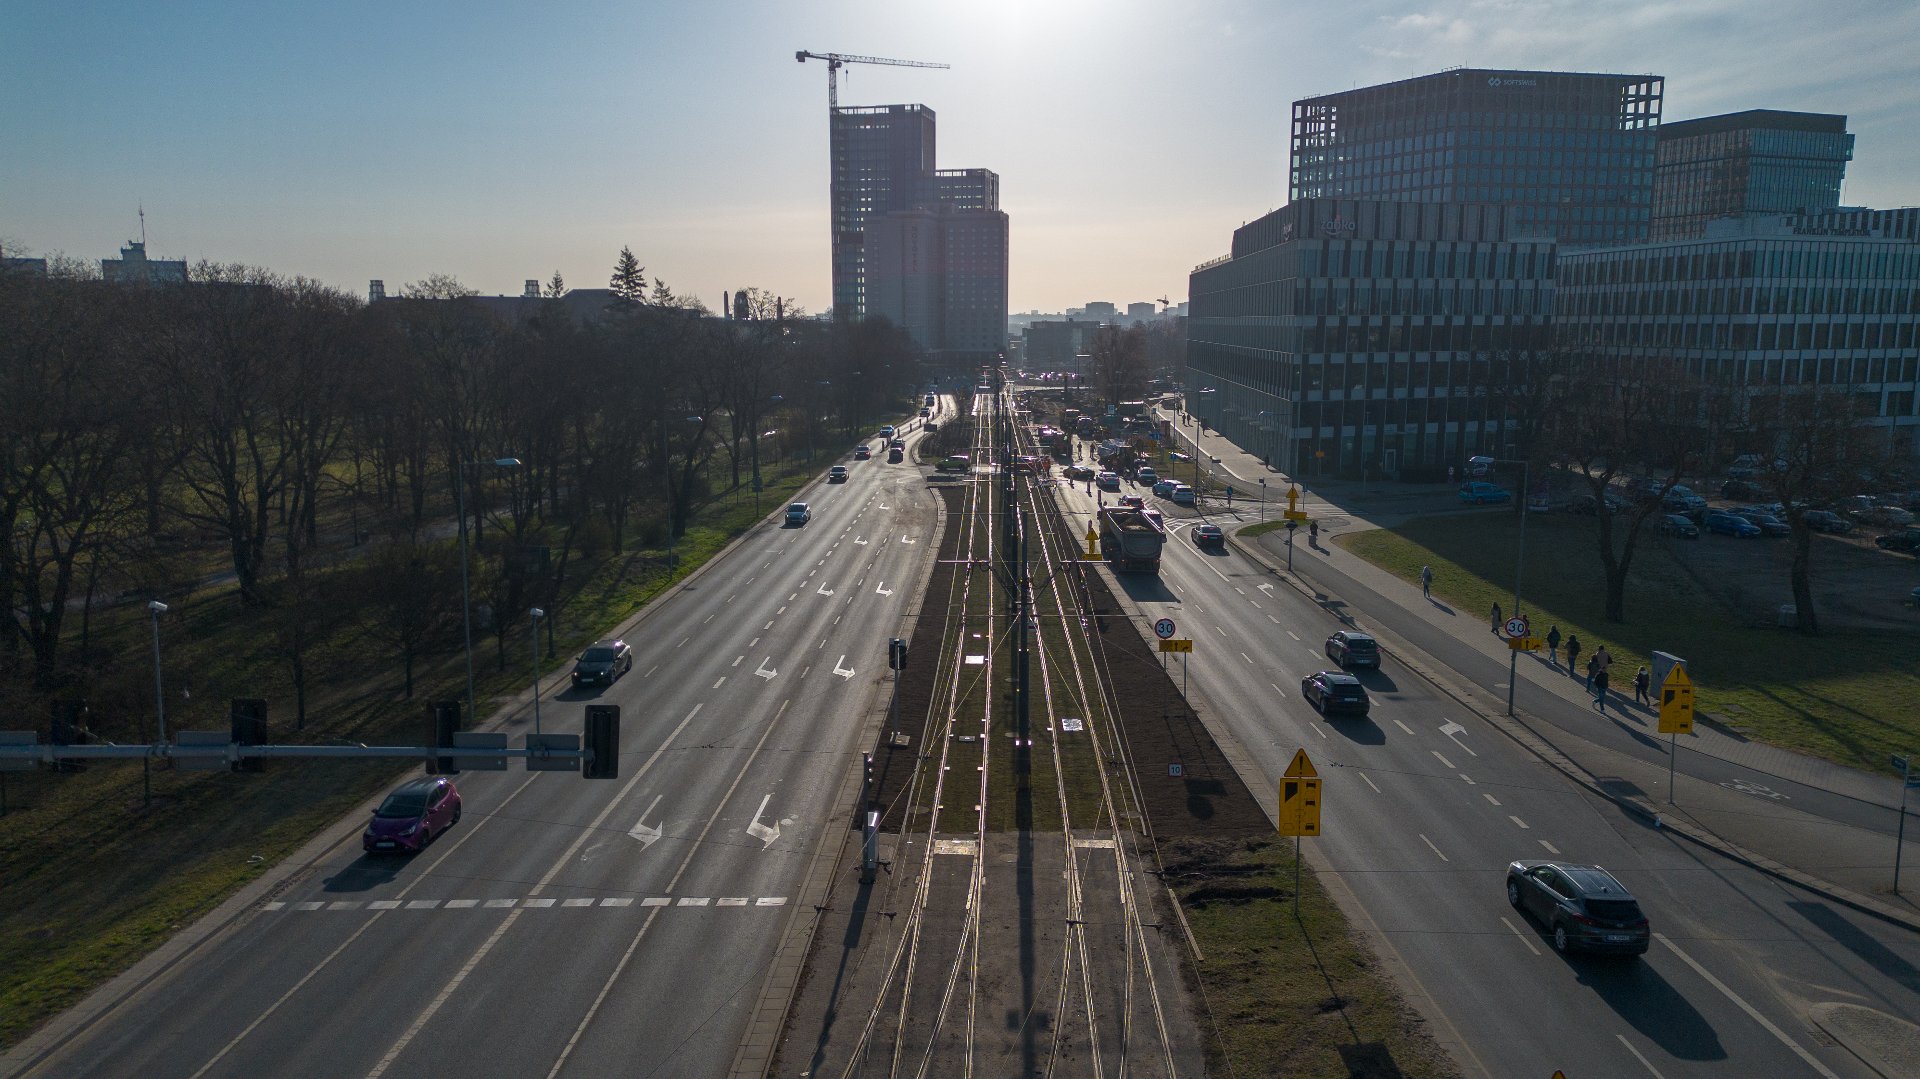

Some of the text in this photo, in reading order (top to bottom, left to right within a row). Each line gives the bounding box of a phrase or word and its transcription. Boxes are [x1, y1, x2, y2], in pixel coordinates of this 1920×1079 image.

[1793, 227, 1829, 236] FRANKLIN
[911, 225, 919, 273] NOVOTEL
[1158, 623, 1173, 633] 30
[1508, 622, 1525, 633] 30
[1171, 766, 1181, 774] 10
